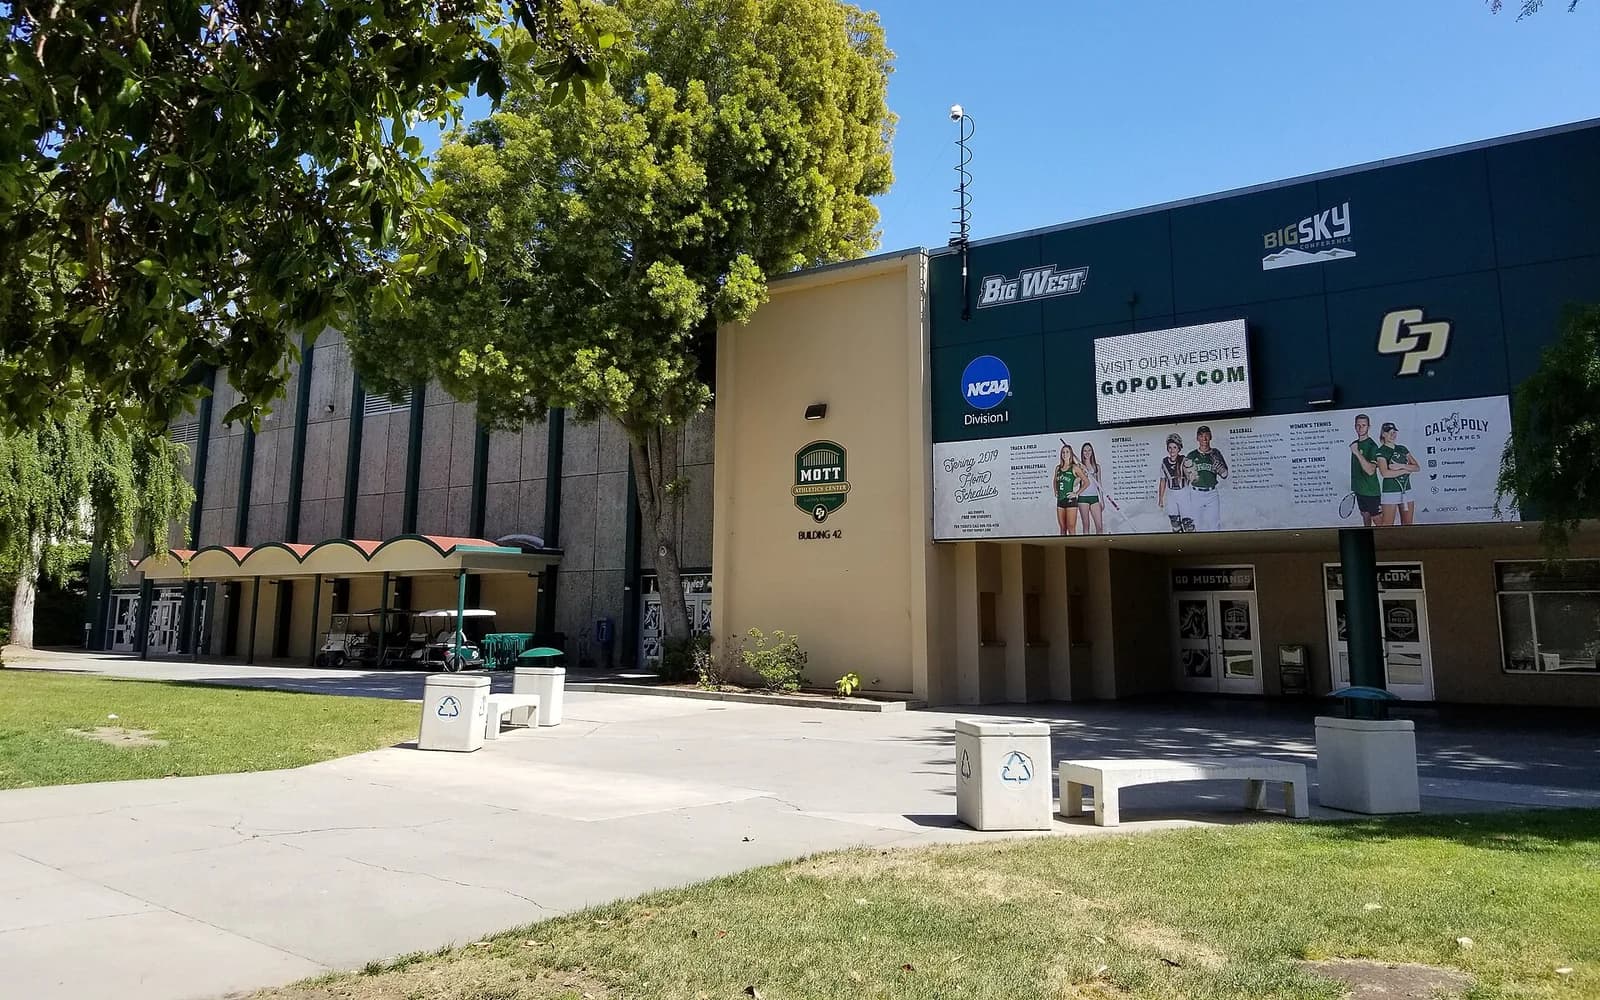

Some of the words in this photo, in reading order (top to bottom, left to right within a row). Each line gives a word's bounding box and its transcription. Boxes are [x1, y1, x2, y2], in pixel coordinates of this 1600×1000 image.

[1299, 236, 1352, 250] CONFERENCE
[981, 278, 1019, 304] BIG
[1021, 269, 1084, 298] WEST
[1100, 359, 1134, 374] VISIT
[1138, 355, 1169, 369] OUR
[1173, 346, 1241, 366] WEBSITE
[967, 379, 1009, 397] NCAA
[1101, 365, 1245, 396] GOPOLY.COM
[964, 411, 1003, 425] Division
[1424, 421, 1447, 437] CAL
[1460, 418, 1489, 433] POLY
[1435, 433, 1481, 442] MUSTANGS
[943, 457, 977, 473] Spring
[978, 449, 999, 464] 2019
[800, 466, 841, 482] MOTT
[958, 470, 992, 489] Home
[954, 485, 999, 503] Schedules
[798, 530, 831, 540] BUILDING
[832, 529, 843, 539] 42
[1175, 575, 1189, 584] GO
[1193, 575, 1252, 585] MUSTANGS
